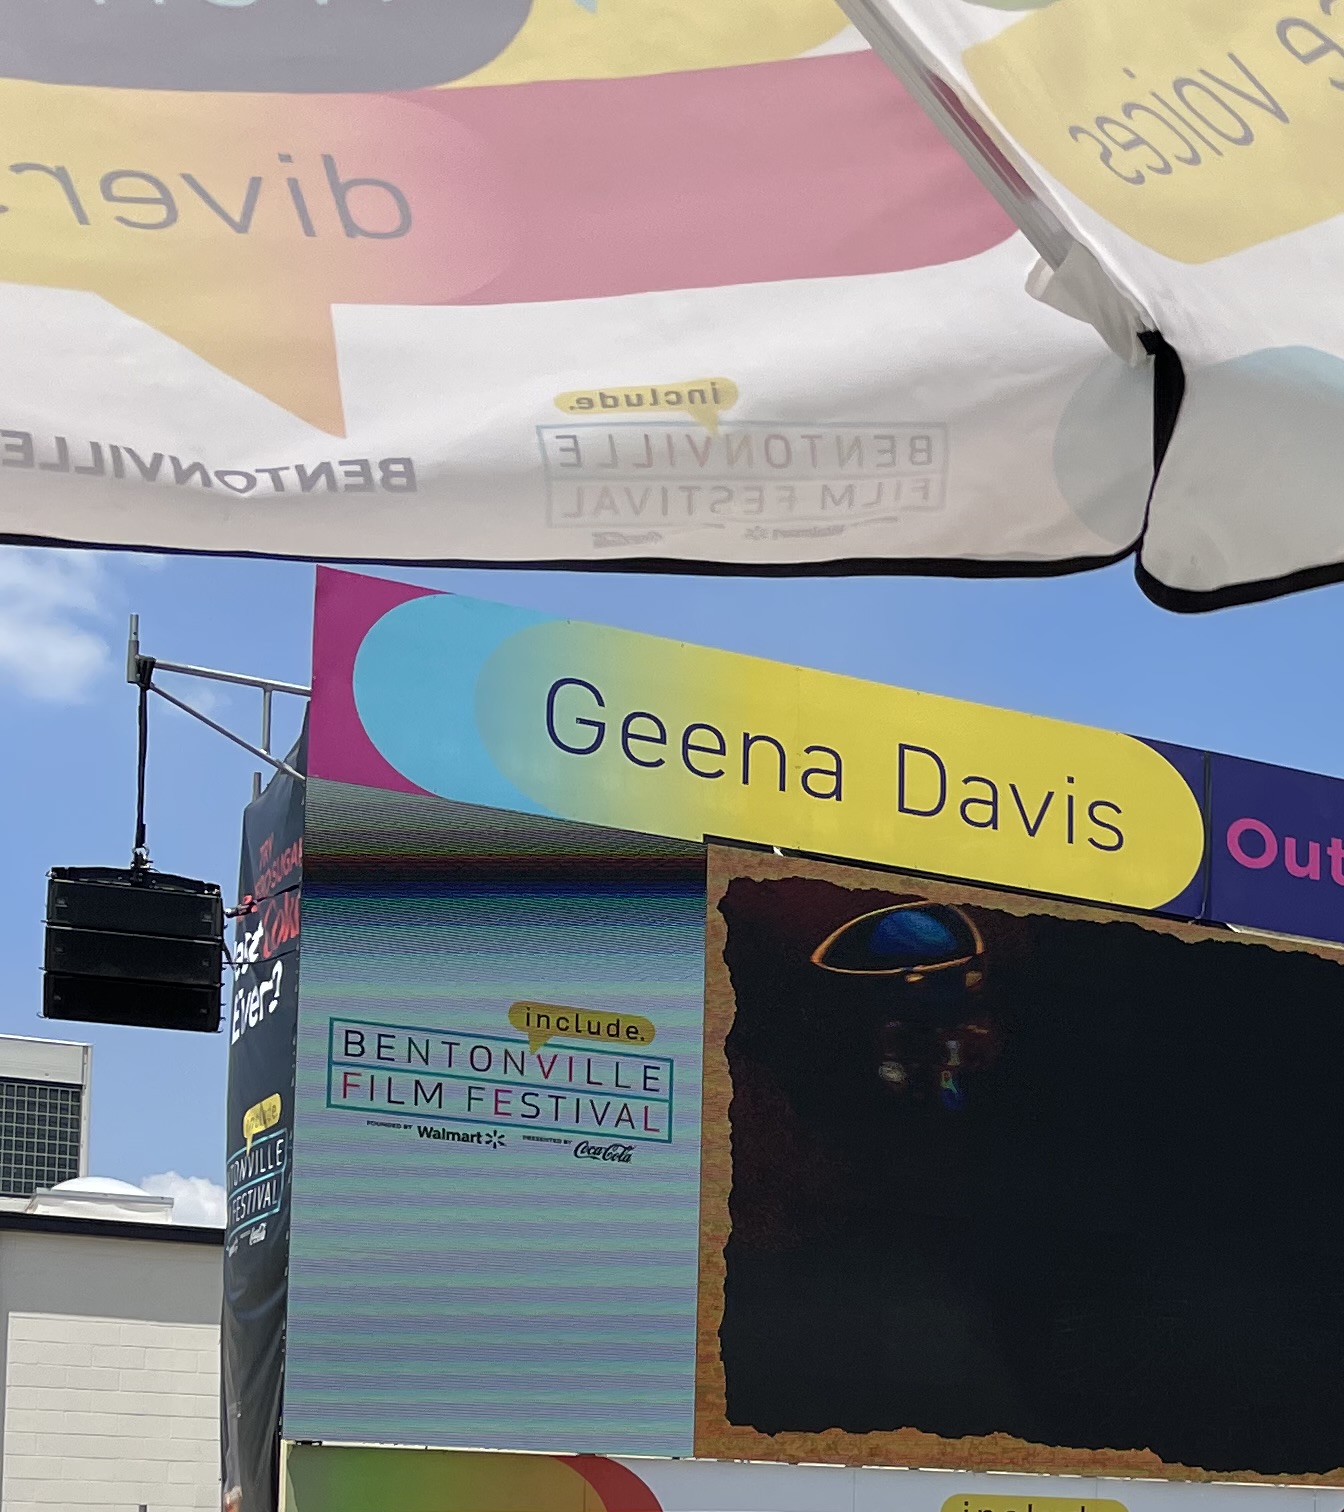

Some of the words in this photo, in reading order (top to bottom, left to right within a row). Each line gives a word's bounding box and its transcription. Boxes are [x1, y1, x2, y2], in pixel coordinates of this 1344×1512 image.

[545, 676, 843, 803] Geena
[897, 742, 1126, 853] Davis
[231, 959, 283, 1046] Ever?
[524, 1007, 646, 1043] include.
[343, 1029, 662, 1093] BENTONVILLE
[341, 1071, 444, 1110] FILM
[466, 1085, 661, 1133] FESTIVAL
[416, 1125, 483, 1146] Walmart
